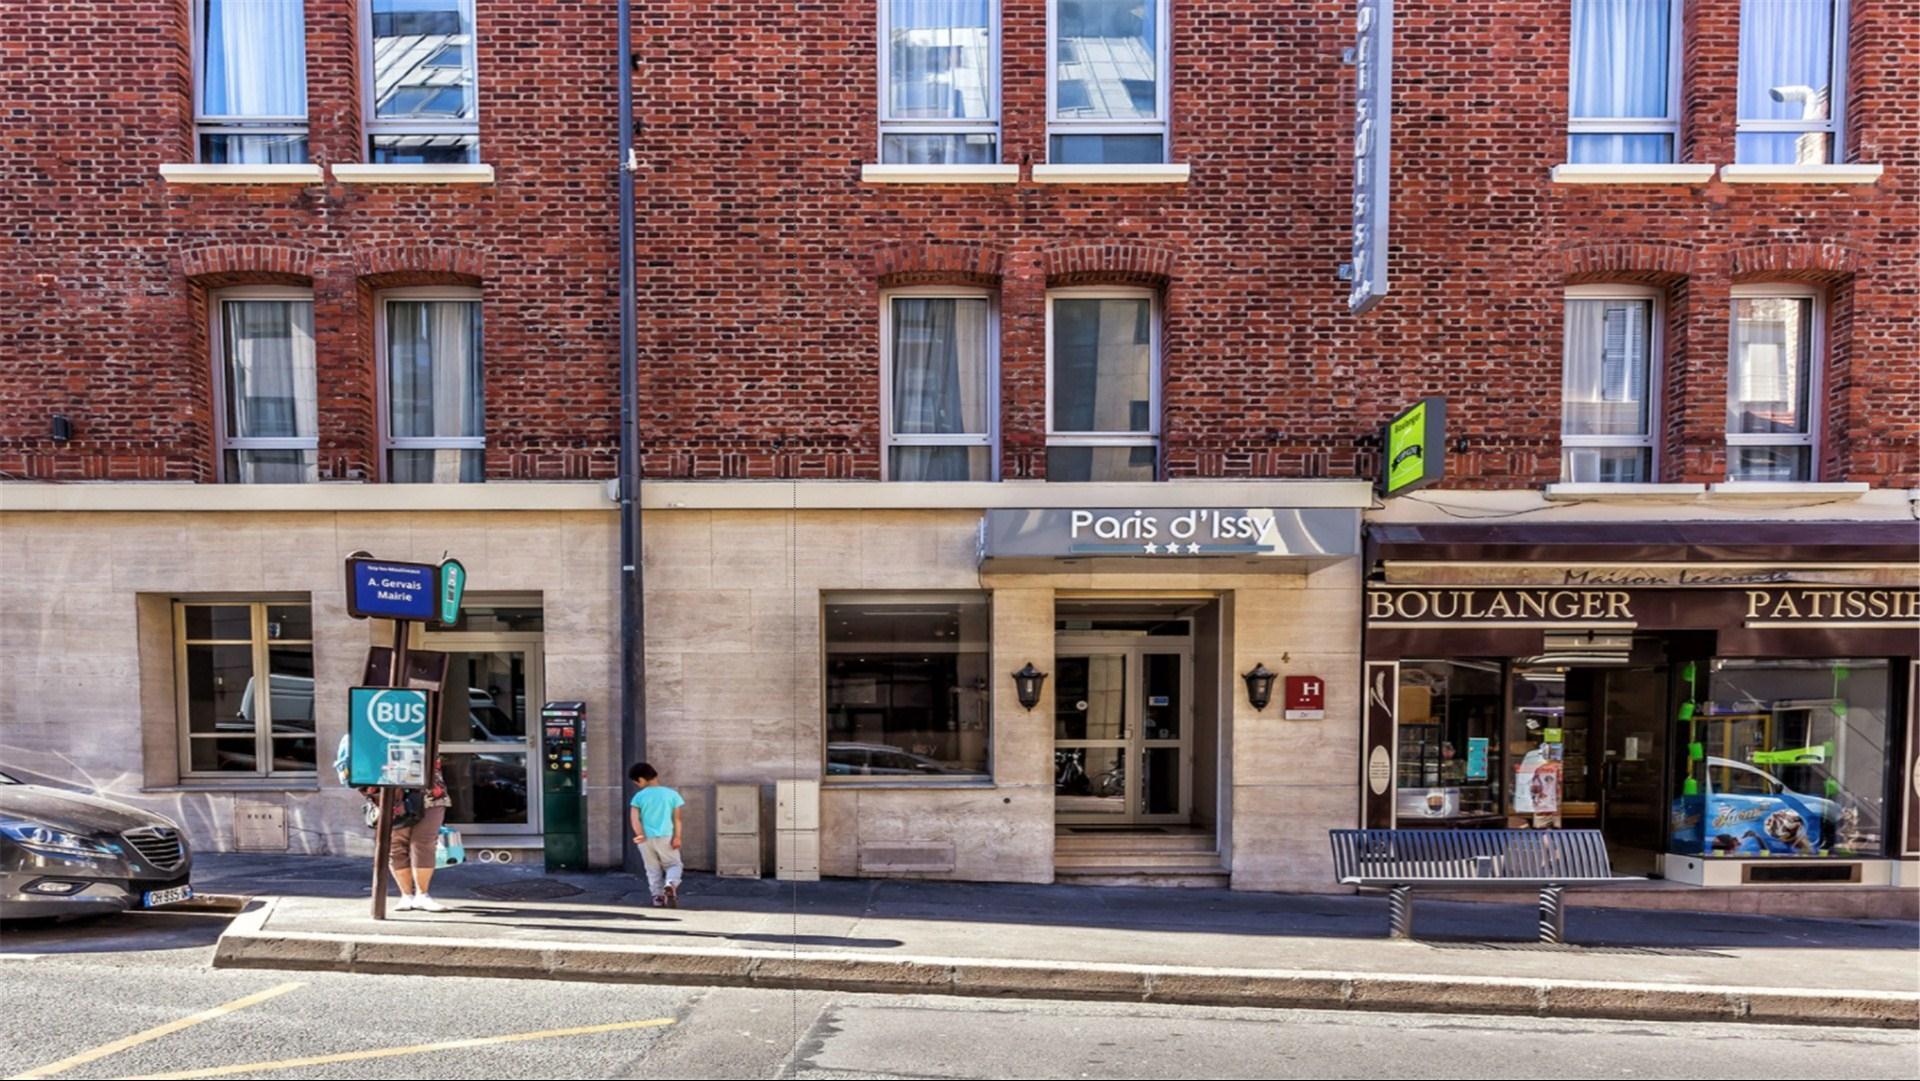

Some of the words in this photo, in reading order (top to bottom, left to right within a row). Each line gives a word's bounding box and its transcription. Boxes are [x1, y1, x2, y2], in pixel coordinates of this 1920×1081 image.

[1070, 510, 1158, 539] Paris
[1169, 509, 1276, 545] d'Issy
[367, 577, 380, 587] A.
[381, 578, 421, 590] Gervais
[1564, 569, 1667, 585] Maison
[377, 591, 413, 602] Mairie
[1368, 590, 1634, 618] BOULANGER
[1280, 651, 1291, 664] 4
[1303, 682, 1319, 696] H
[377, 702, 425, 724] BUS
